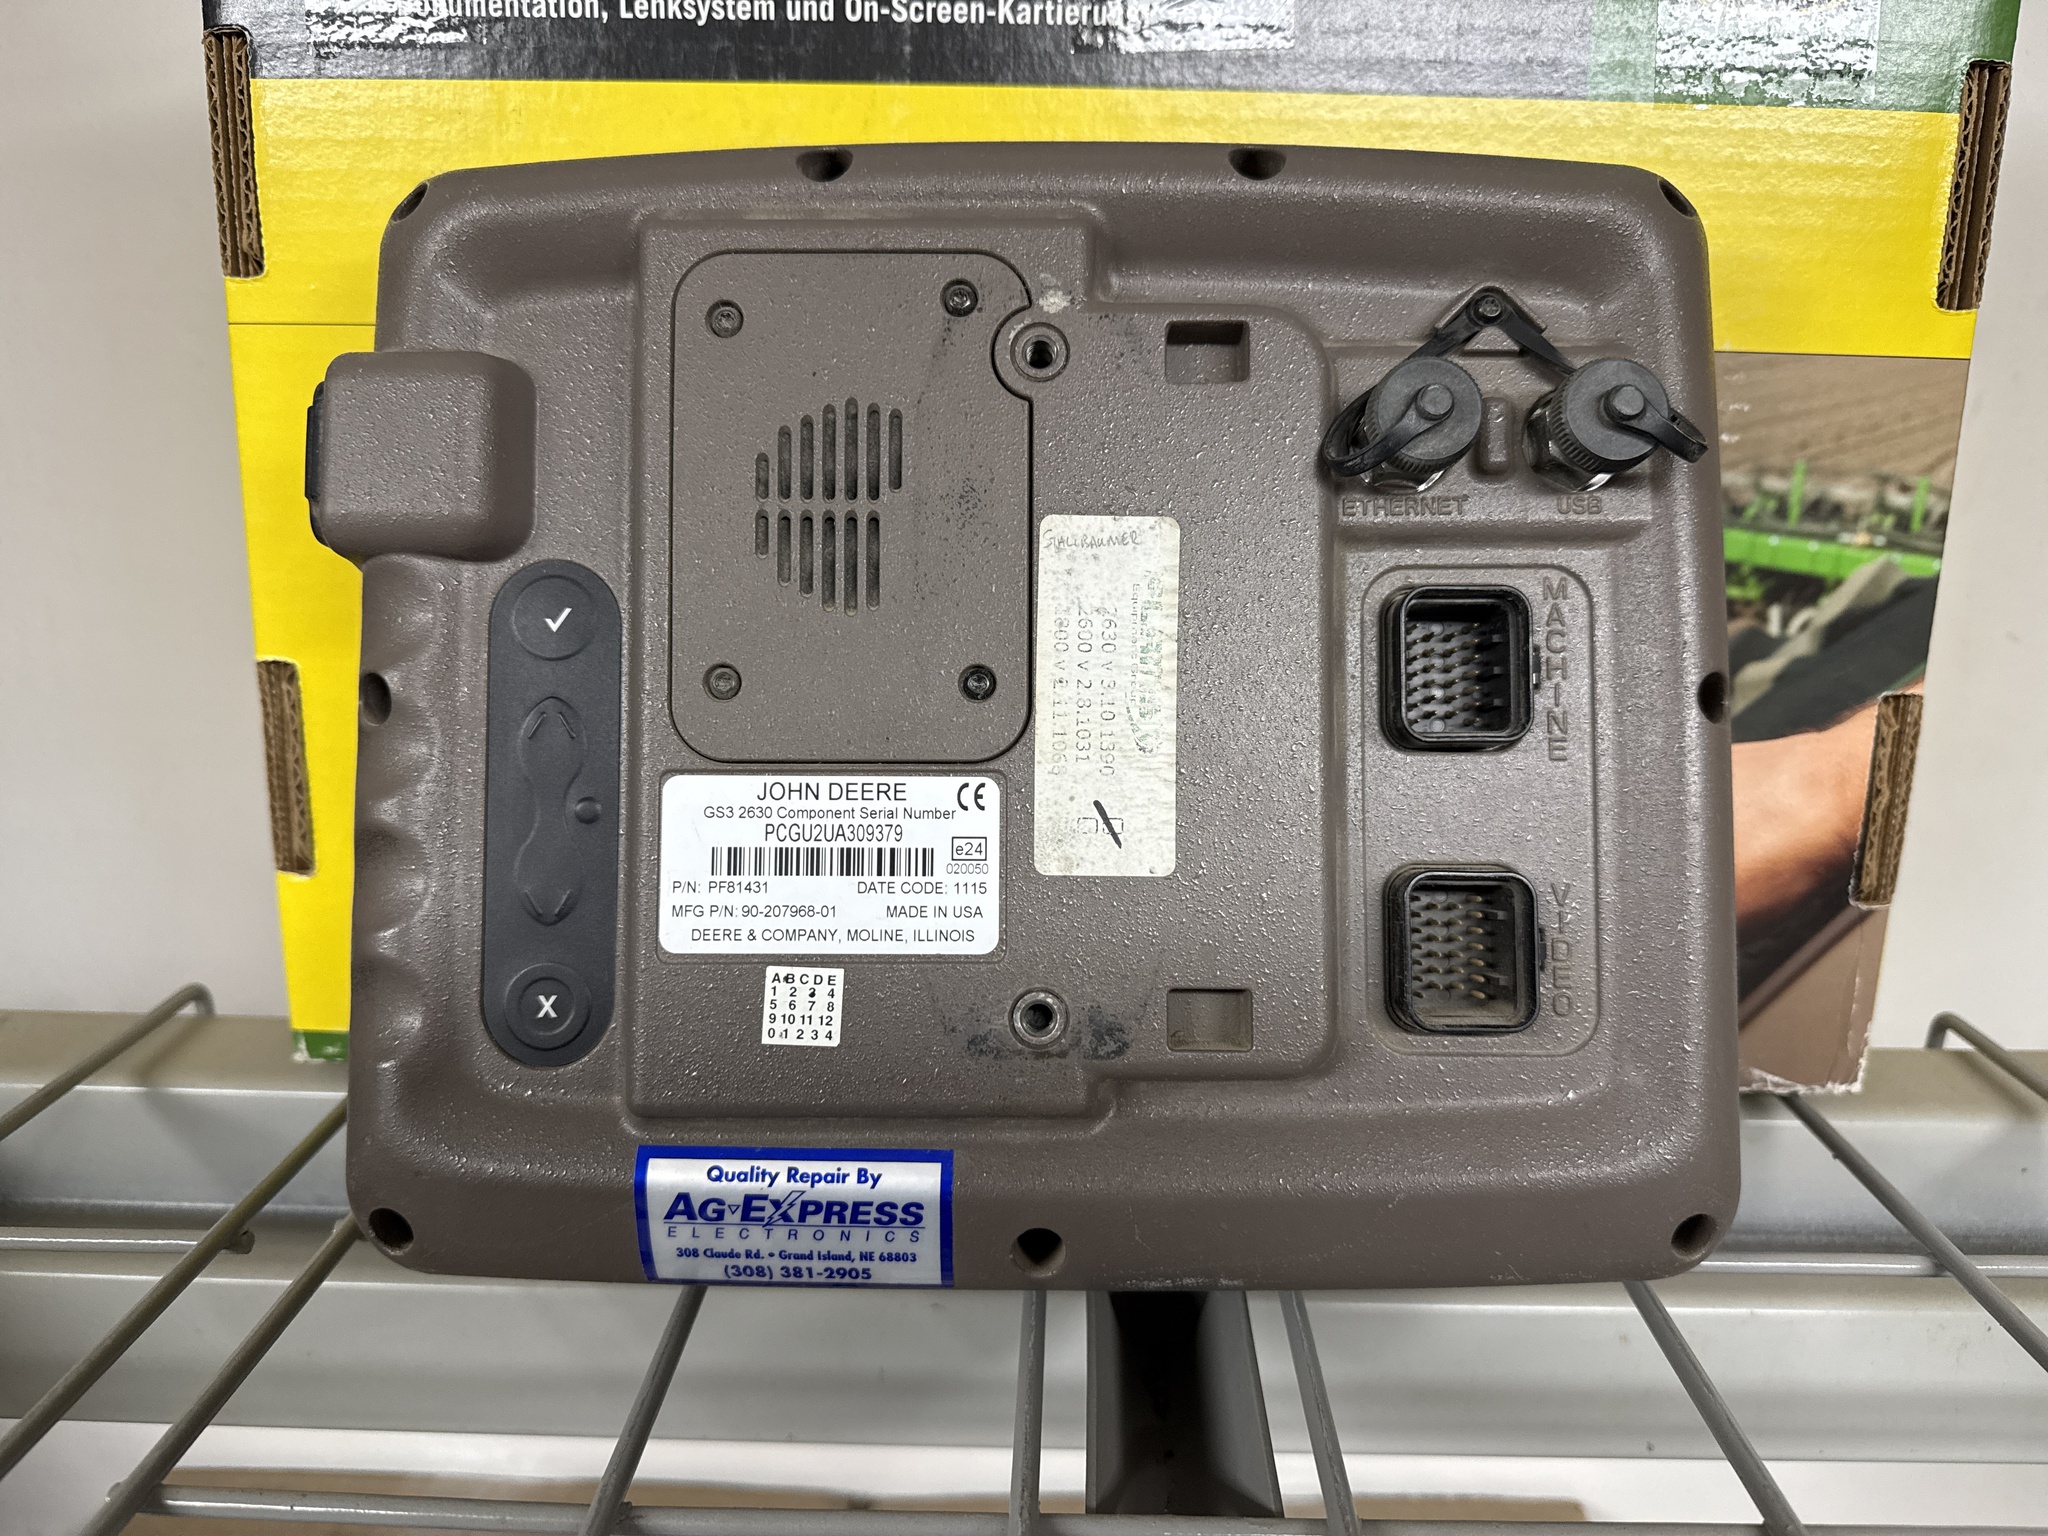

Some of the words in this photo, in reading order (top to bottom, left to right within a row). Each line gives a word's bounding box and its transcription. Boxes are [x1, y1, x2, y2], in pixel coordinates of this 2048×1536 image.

[402, 0, 609, 24] umentation,
[620, 0, 775, 27] Lenksystem
[786, 0, 834, 22] und
[1341, 495, 1468, 517] ETHERNET
[1556, 494, 1603, 515] USB
[1542, 576, 1568, 761] MACHINE
[757, 782, 820, 801] JOHN
[829, 782, 907, 801] DEERE
[704, 806, 734, 819] GS3
[738, 806, 773, 819] 2630
[777, 806, 855, 821] Component
[860, 807, 898, 820] Serial
[903, 807, 957, 820] Number
[764, 823, 903, 842] PCGU2UA309379
[955, 842, 983, 856] e24
[946, 862, 989, 875] 020050
[672, 881, 701, 895] P/N:
[708, 882, 769, 893] PF81431
[857, 882, 896, 894] DATE
[900, 882, 948, 894] CODE:
[954, 882, 988, 895] 1115
[672, 905, 704, 918] MFG
[709, 905, 738, 918] P/N:
[741, 905, 837, 918] 90-207968-01
[886, 905, 928, 918] MADE
[933, 906, 948, 918] IN
[954, 906, 984, 918] USA
[691, 929, 744, 942] DEERE
[747, 929, 757, 942] &
[761, 929, 842, 944] COMPANY,
[847, 929, 908, 944] MOLINE,
[913, 929, 976, 943] ILLINOIS
[1551, 882, 1572, 1017] VIDEO
[771, 972, 781, 984] A
[785, 973, 795, 984] B
[799, 973, 810, 985] C
[813, 974, 824, 986] D
[827, 975, 837, 986] E
[771, 985, 777, 996] 1
[789, 986, 797, 997] 2
[827, 988, 835, 999] 4
[769, 999, 777, 1010] 5
[788, 1000, 797, 1011] 6
[808, 1000, 816, 1011] 7
[826, 1001, 835, 1012] 8
[768, 1013, 777, 1024] 9
[780, 1013, 796, 1025] 10
[799, 1014, 812, 1025] 11
[818, 1015, 833, 1026] 12
[767, 1027, 776, 1039] 0
[782, 1028, 788, 1039] 1
[796, 1029, 804, 1040] 2
[810, 1029, 819, 1040] 3
[825, 1030, 833, 1041] 4
[706, 1165, 781, 1188] Quality
[786, 1167, 850, 1189] Repair
[856, 1168, 883, 1189] By
[676, 1247, 700, 1259] 308
[703, 1248, 742, 1260] Claude
[745, 1248, 765, 1260] Rd.
[778, 1250, 815, 1261] Grand
[817, 1250, 856, 1263] Island,
[859, 1251, 876, 1263] NE
[878, 1251, 917, 1263] 68803
[724, 1264, 774, 1280] (308)
[780, 1264, 872, 1280] 381-2905
